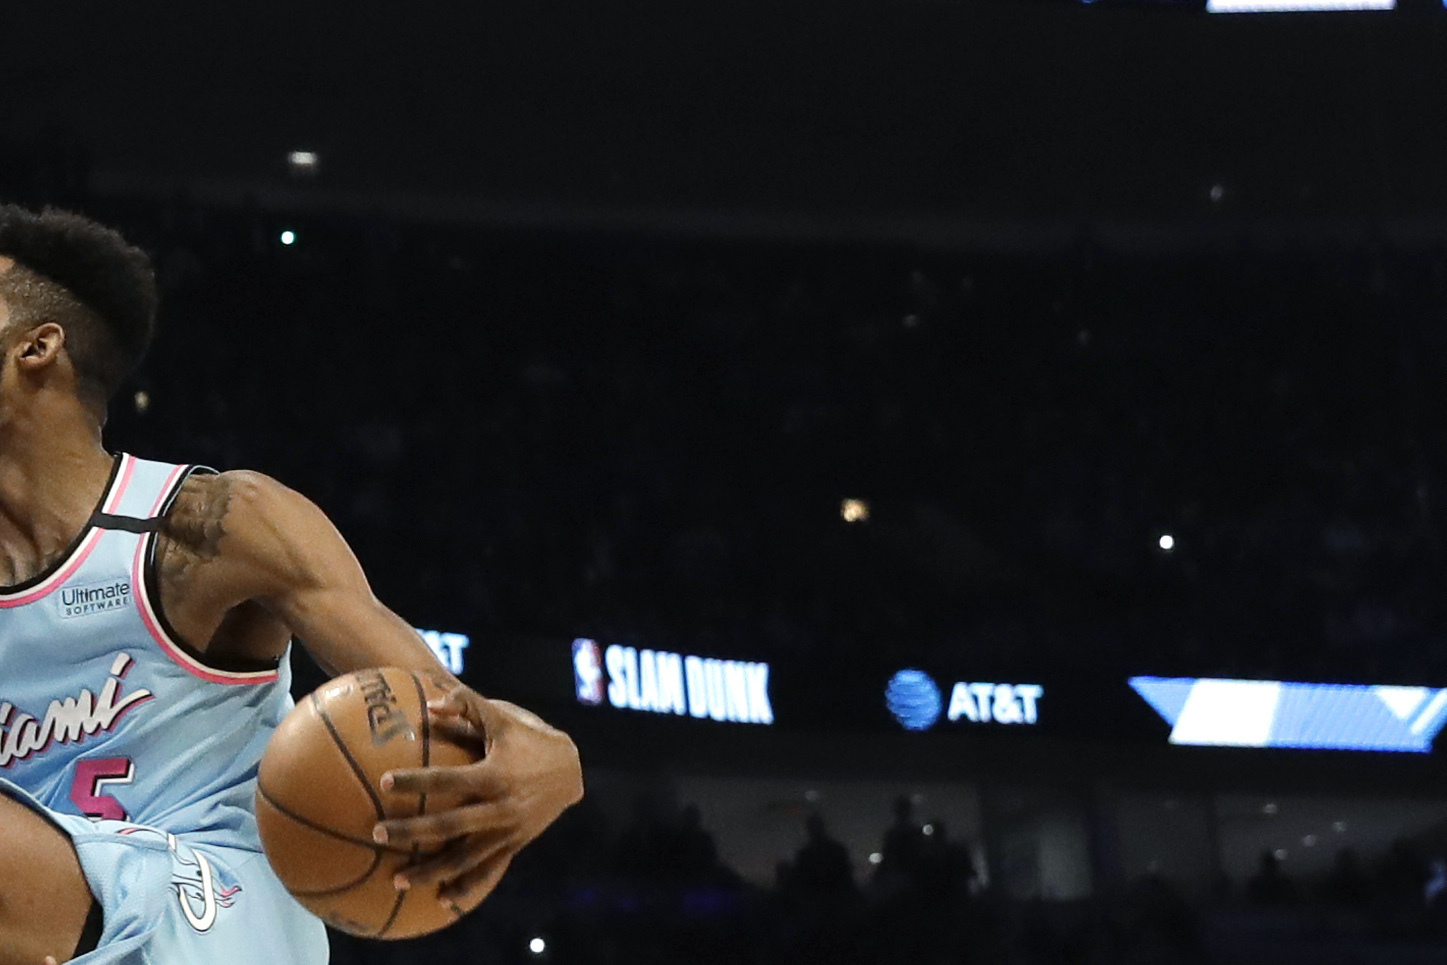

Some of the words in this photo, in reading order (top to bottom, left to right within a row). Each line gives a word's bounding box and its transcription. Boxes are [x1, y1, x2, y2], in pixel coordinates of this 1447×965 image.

[62, 582, 130, 606] Ultimate
[65, 597, 129, 616] SOFTWARE
[605, 643, 687, 716] SLAM
[684, 654, 775, 726] DUNK
[947, 682, 1044, 724] AT&T
[70, 757, 136, 822] 5
